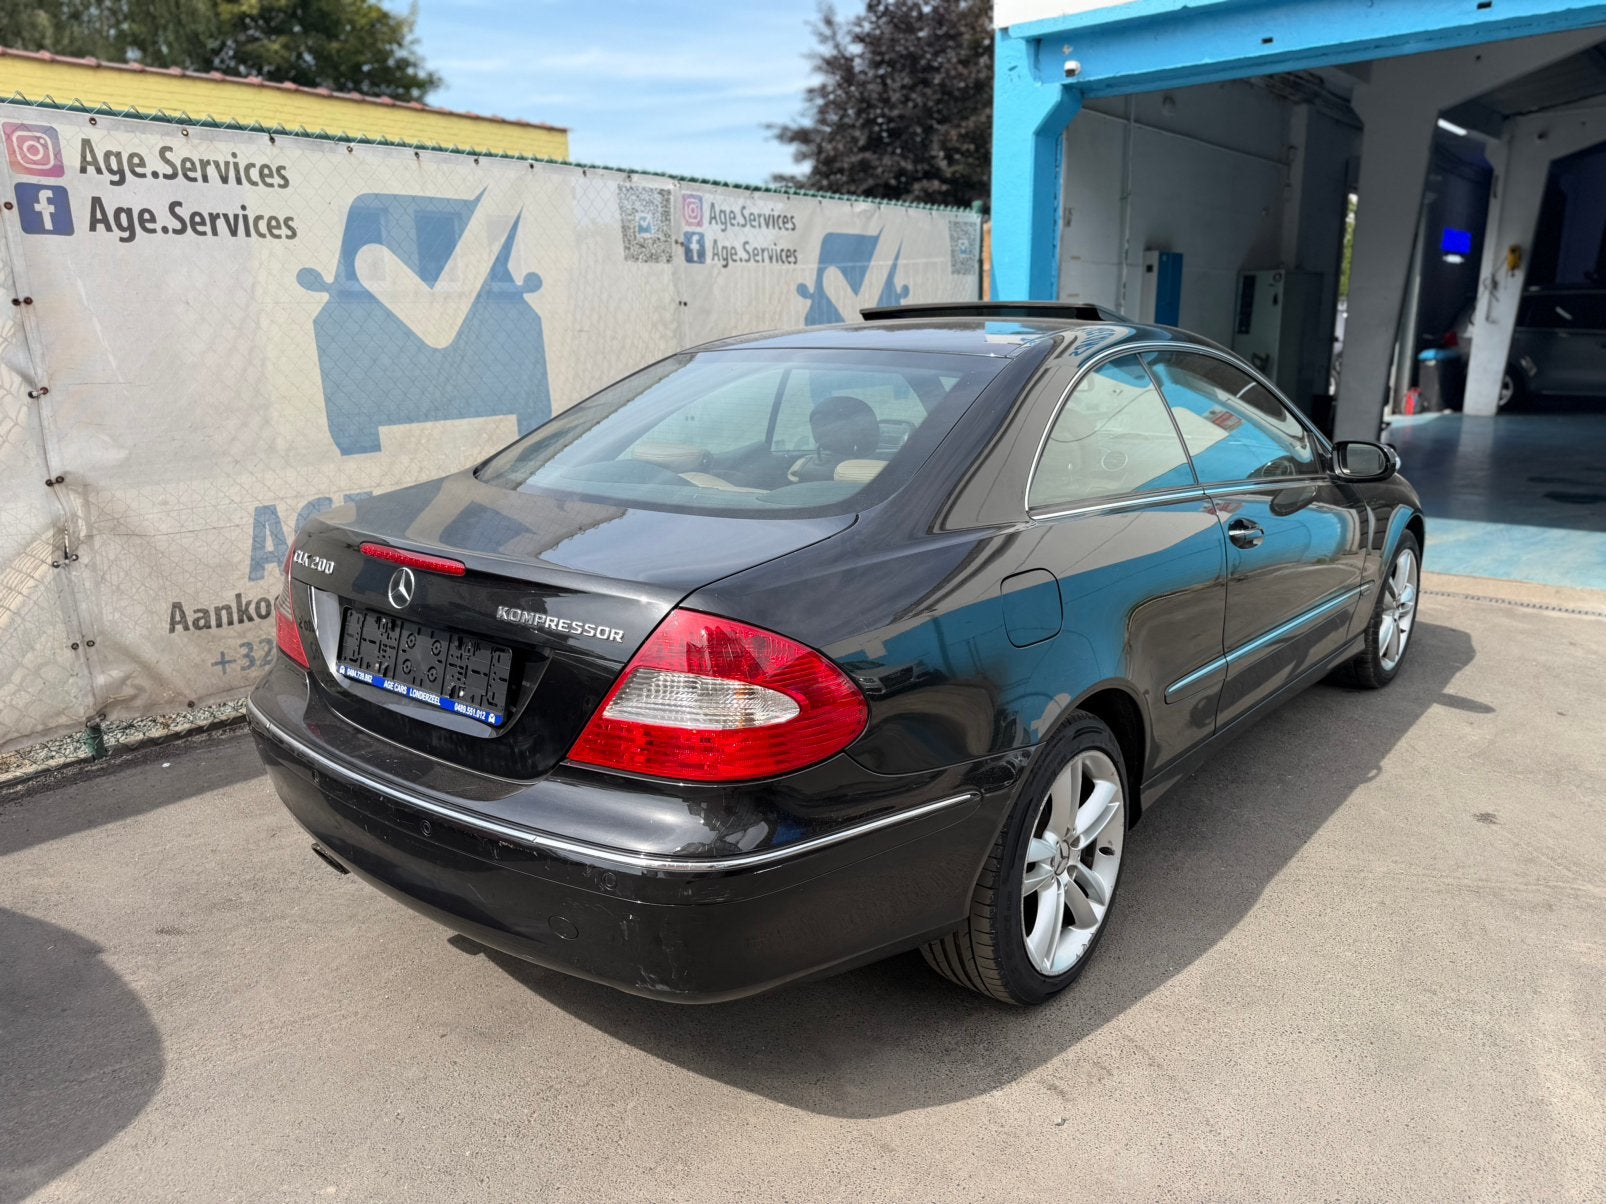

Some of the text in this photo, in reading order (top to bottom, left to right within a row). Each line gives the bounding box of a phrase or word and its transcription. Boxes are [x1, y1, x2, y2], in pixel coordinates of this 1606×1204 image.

[79, 138, 290, 189] Age.Services
[88, 196, 298, 243] Age.Services
[708, 202, 797, 232] Age.Services
[711, 239, 798, 268] Age.Services
[293, 549, 335, 575] CLK 200
[168, 592, 280, 634] Aanko
[496, 606, 625, 643] KOMPRESSOR
[383, 679, 442, 705] AGE CARS LONDERZEEL
